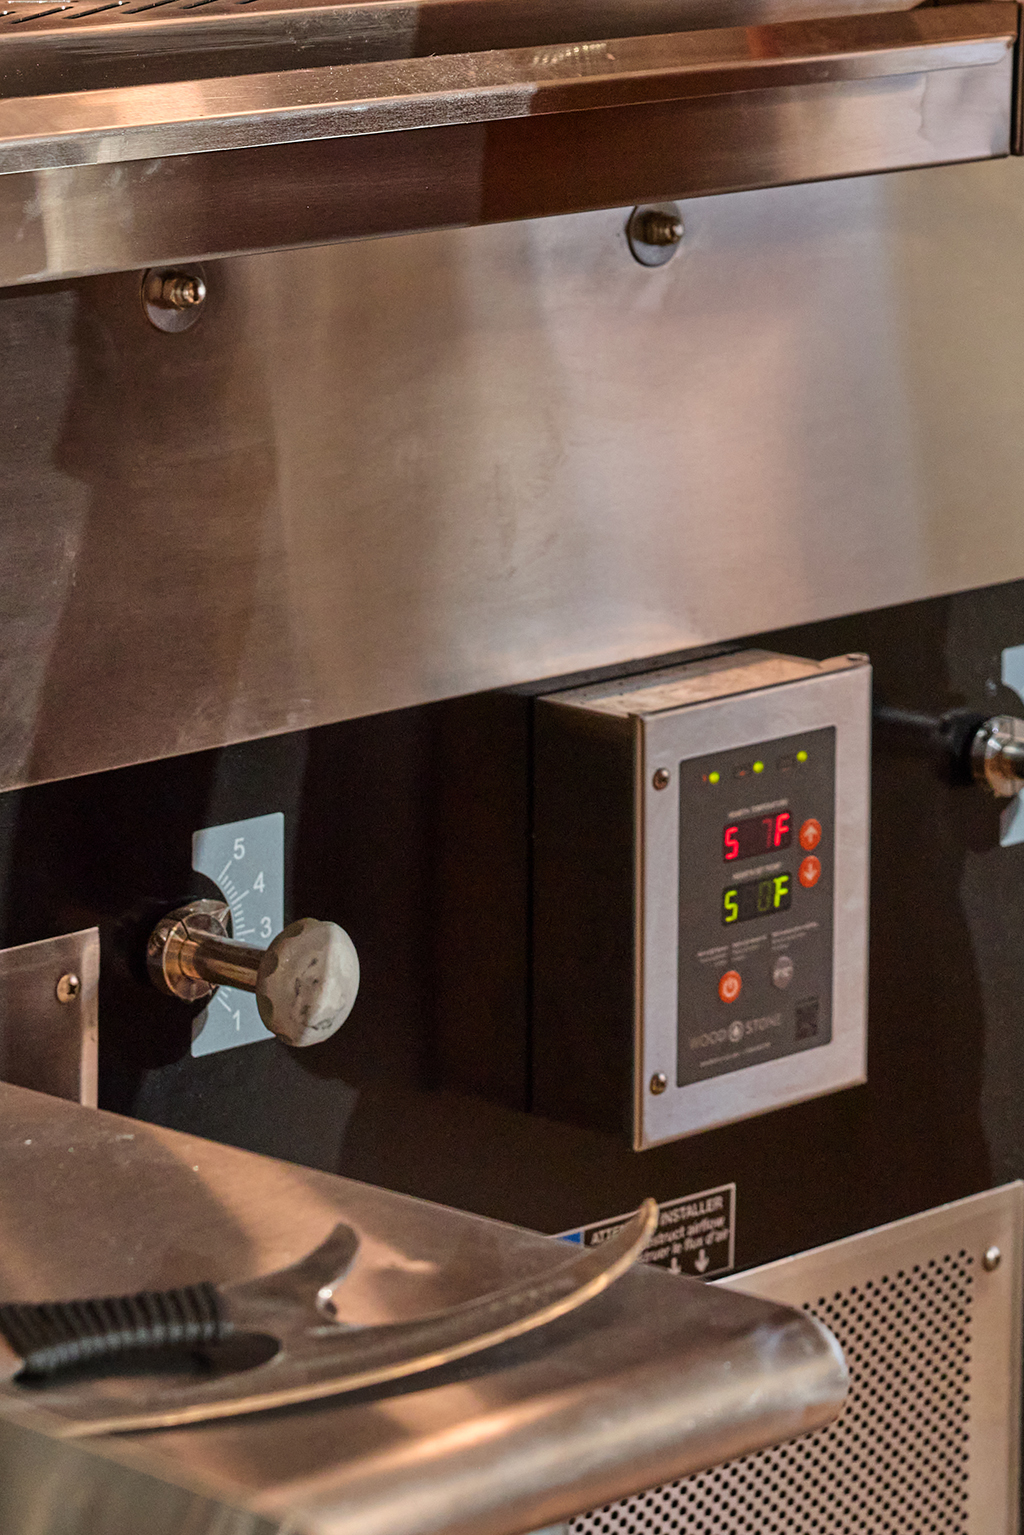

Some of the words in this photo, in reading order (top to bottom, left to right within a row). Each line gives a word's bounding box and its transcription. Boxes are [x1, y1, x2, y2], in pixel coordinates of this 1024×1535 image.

[233, 837, 246, 861] 5
[252, 871, 266, 894] 4
[259, 916, 273, 939] 3
[232, 1009, 241, 1032] 1
[659, 1194, 724, 1227] INSTALLER
[686, 1216, 726, 1237] airflow
